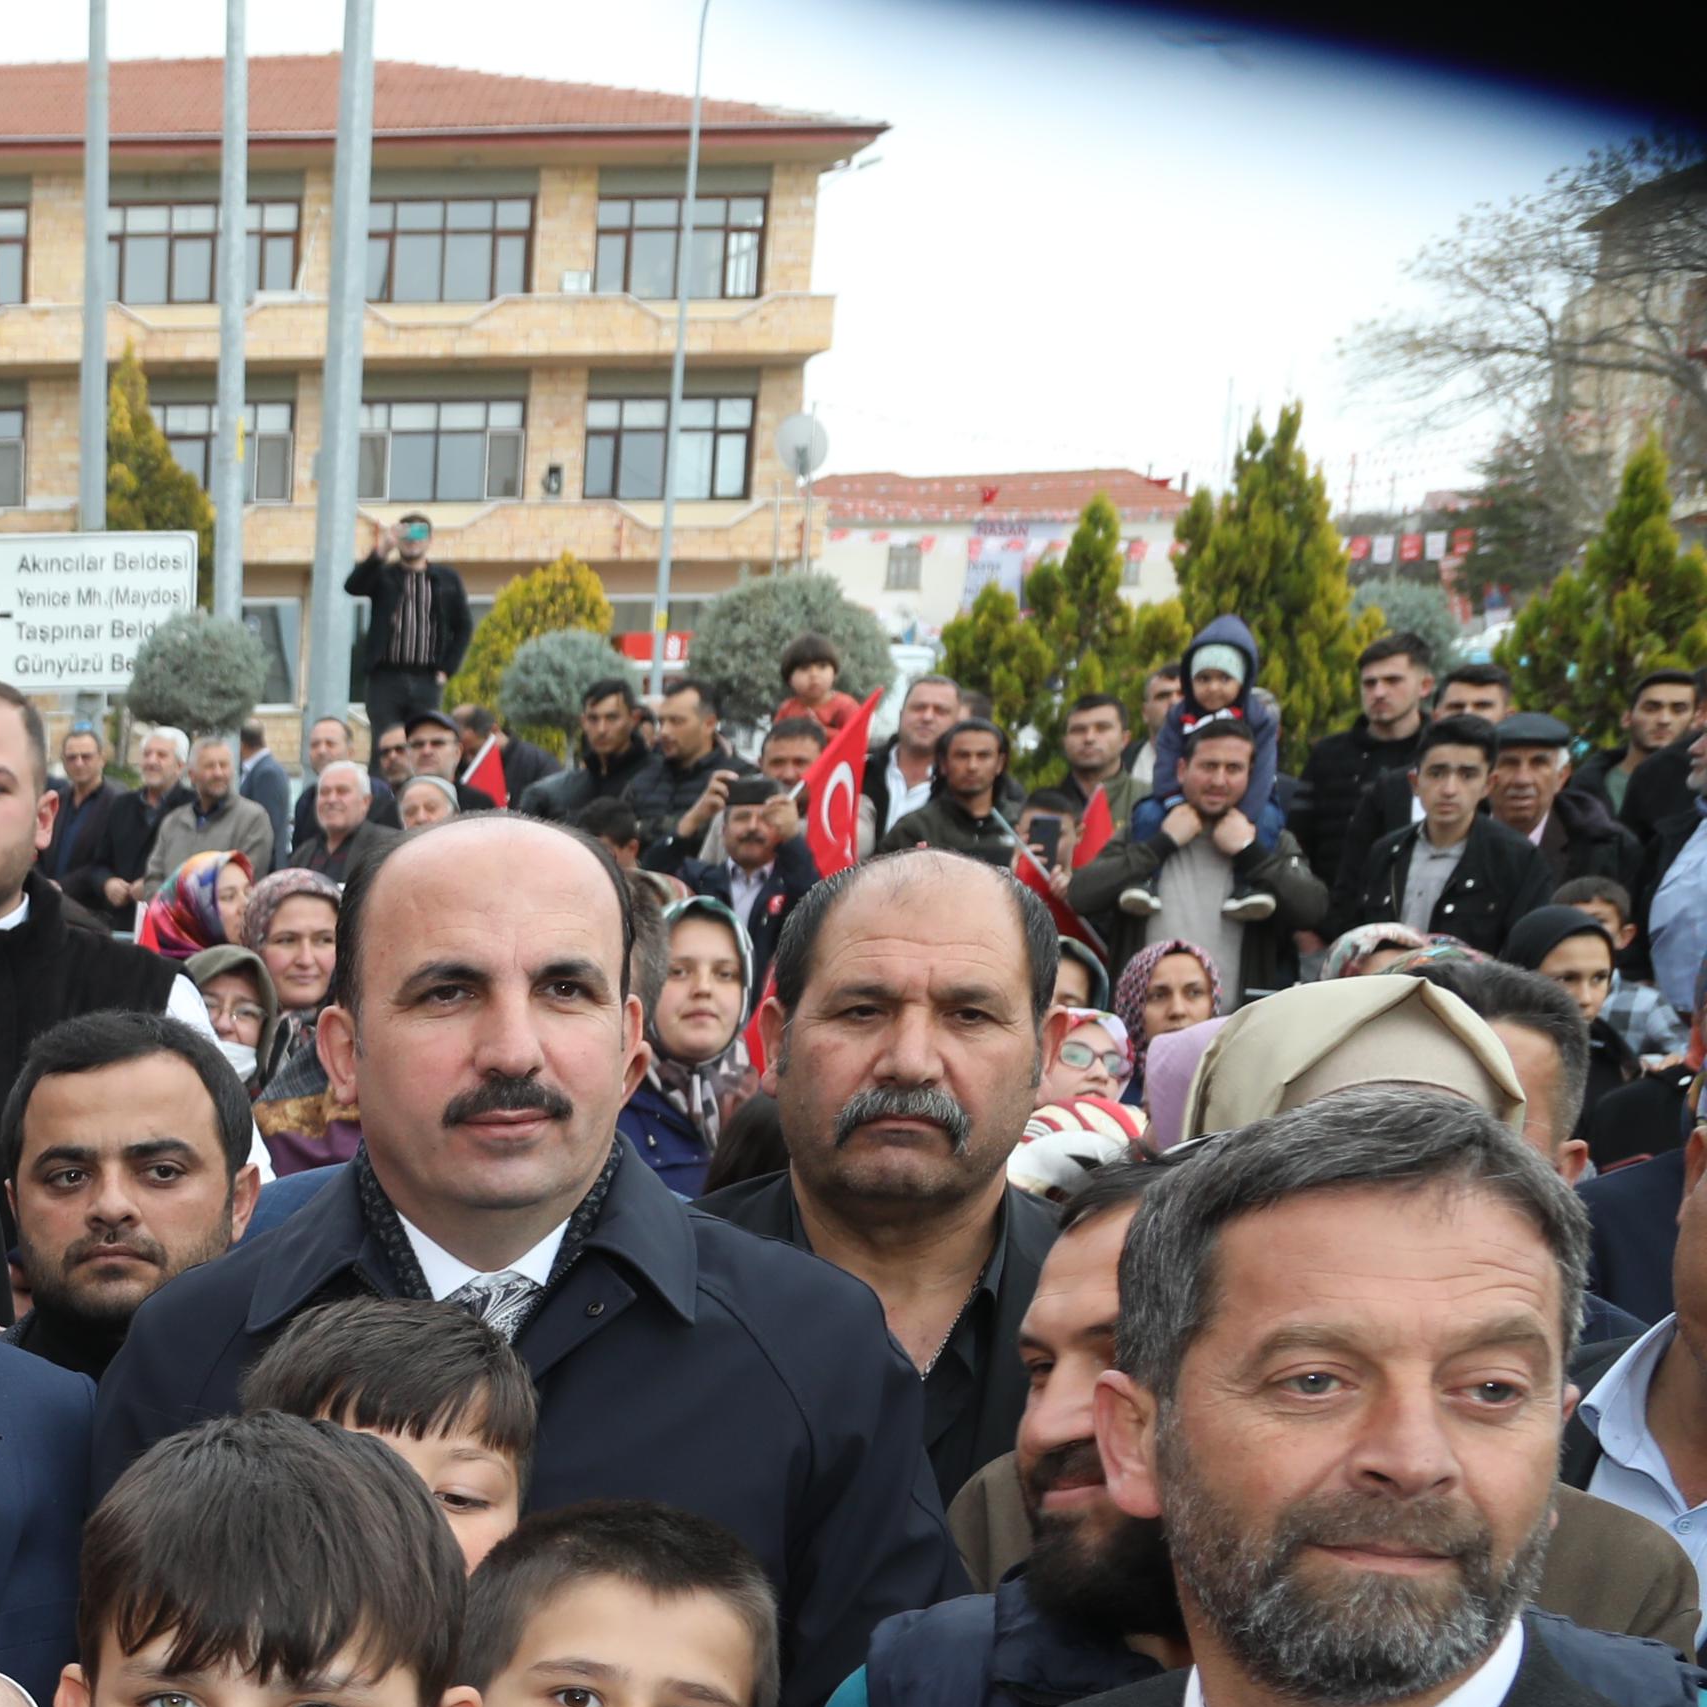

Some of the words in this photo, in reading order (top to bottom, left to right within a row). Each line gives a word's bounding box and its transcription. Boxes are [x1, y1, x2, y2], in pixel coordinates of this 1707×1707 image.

[18, 554, 105, 574] Akıncılar
[114, 551, 188, 571] Beldesi
[17, 587, 71, 607] Yenice
[16, 621, 102, 644] Taşpınar
[15, 654, 103, 678] Günyüzü
